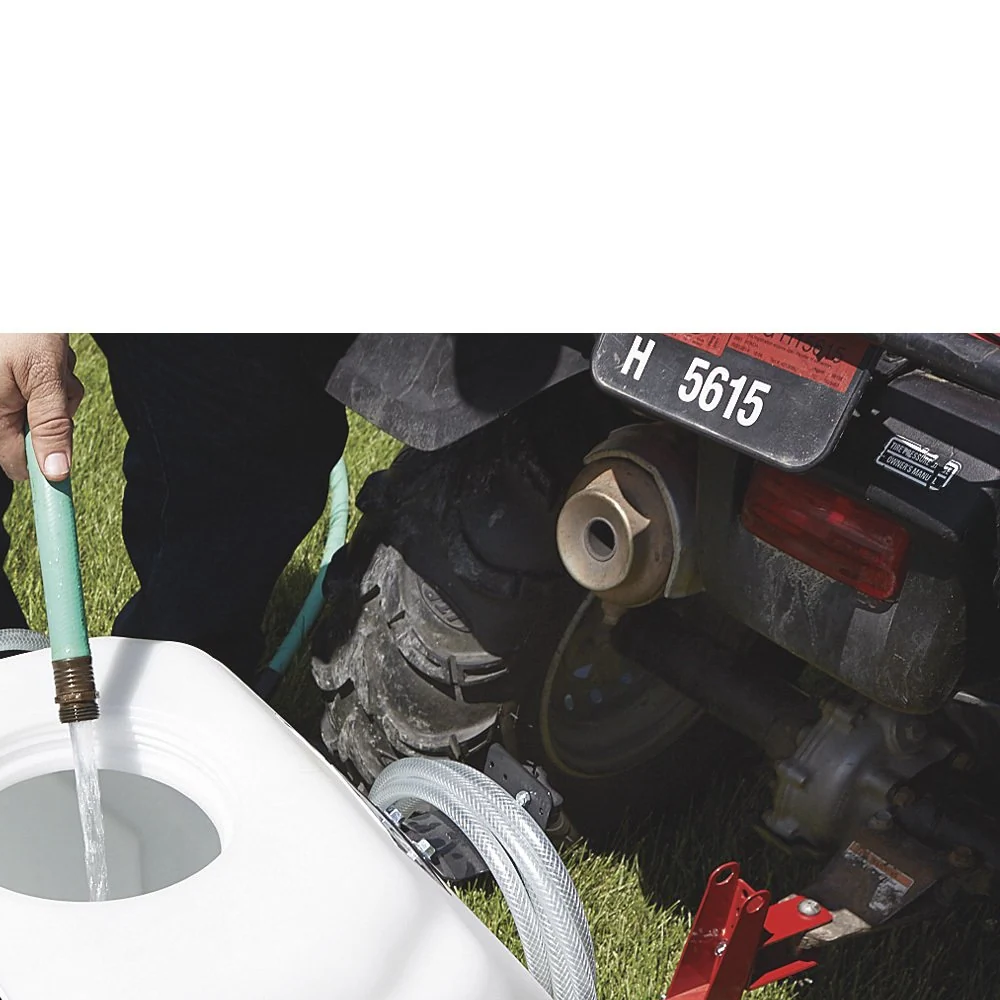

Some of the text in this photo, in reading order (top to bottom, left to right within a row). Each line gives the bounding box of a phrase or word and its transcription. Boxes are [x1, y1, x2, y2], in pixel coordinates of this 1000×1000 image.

[620, 335, 656, 381] H
[678, 357, 772, 427] 5615
[890, 442, 905, 455] TIRE
[911, 467, 938, 485] MANUL
